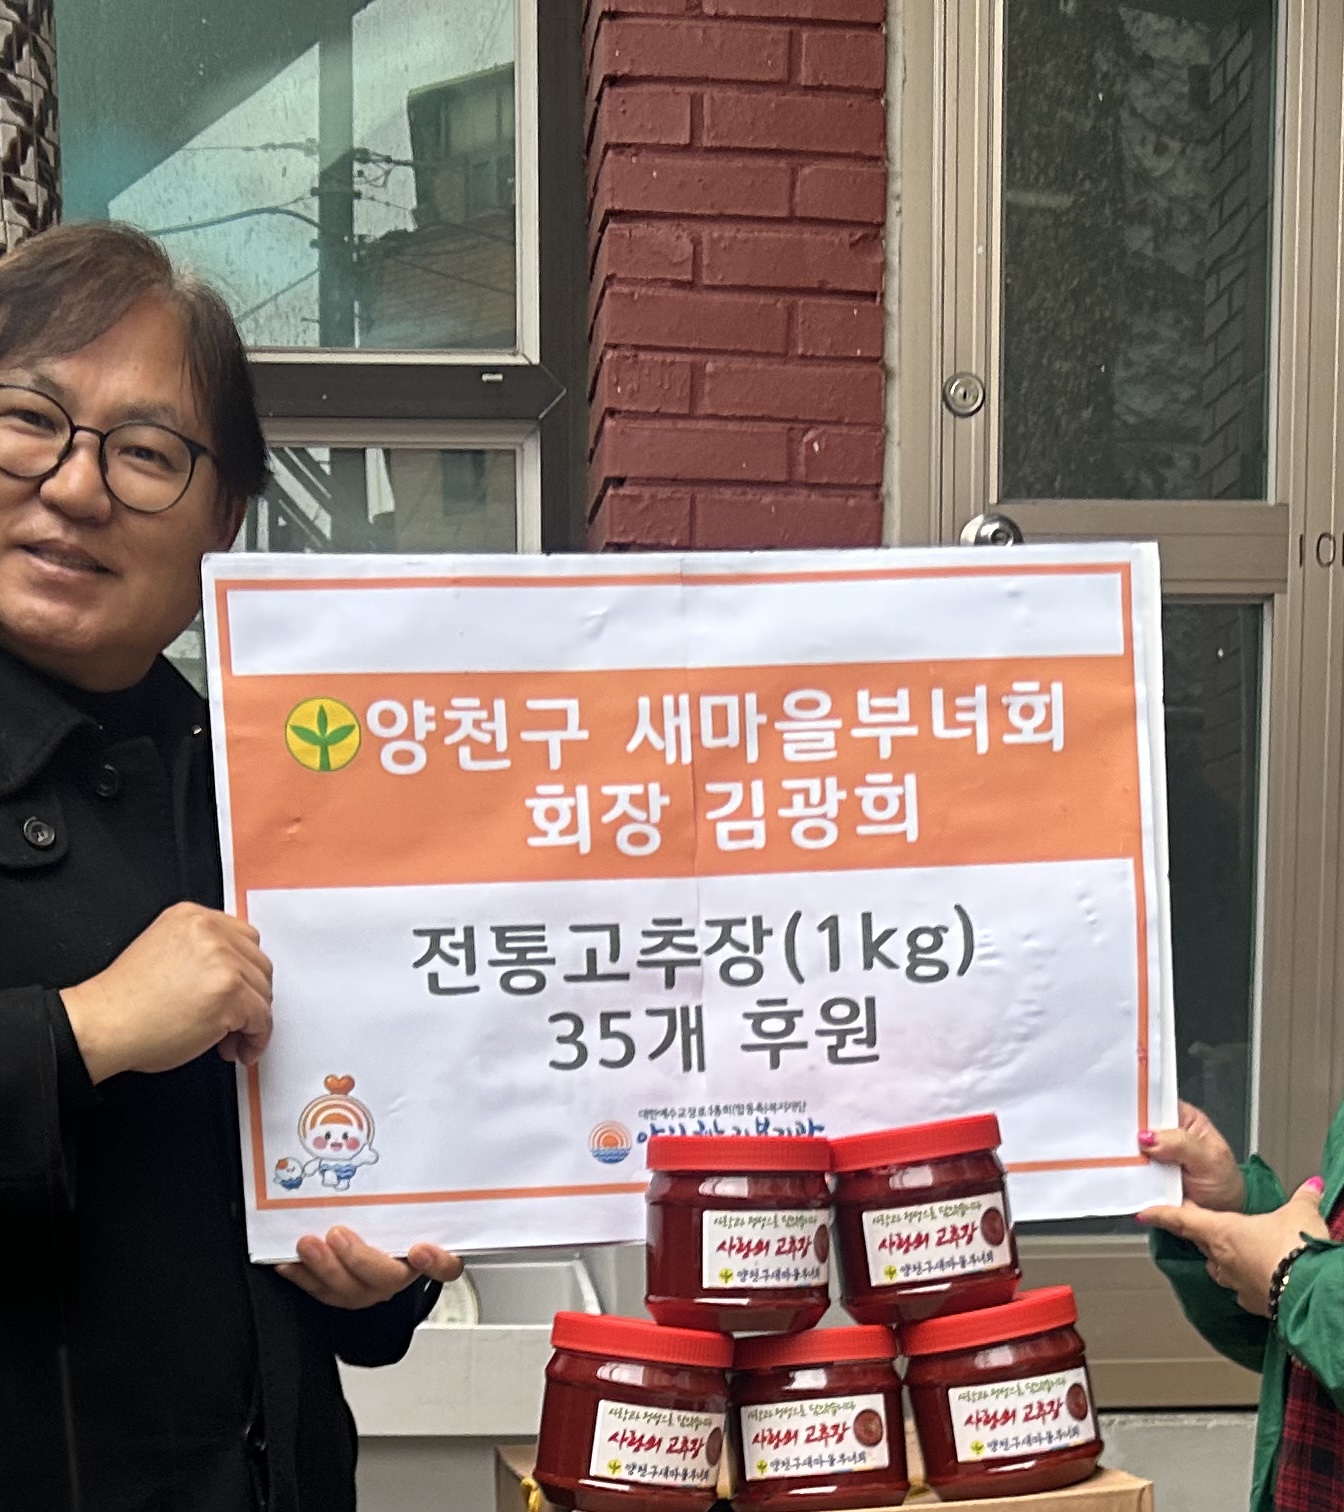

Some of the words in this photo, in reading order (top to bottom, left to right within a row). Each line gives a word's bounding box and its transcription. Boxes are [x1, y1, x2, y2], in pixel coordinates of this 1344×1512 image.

[365, 695, 590, 774] 양천구
[628, 680, 1067, 767] 새마을부녀회
[525, 782, 669, 856] 회장
[704, 772, 920, 852] 김광희
[412, 904, 979, 998] 전통고추장(1kg)
[548, 1003, 709, 1072] 35개
[741, 996, 882, 1067] 후원
[716, 1235, 770, 1260] 사랑의
[774, 1235, 813, 1261] 고추장
[878, 1231, 930, 1256] 사랑의
[935, 1220, 979, 1252] 고추장
[964, 1408, 1016, 1431] 사랑의
[1022, 1397, 1064, 1425] 고추장
[608, 1428, 663, 1454] 사랑의
[666, 1434, 705, 1462] 고추장
[752, 1427, 799, 1450] 사랑의
[804, 1420, 852, 1449] 고추장
